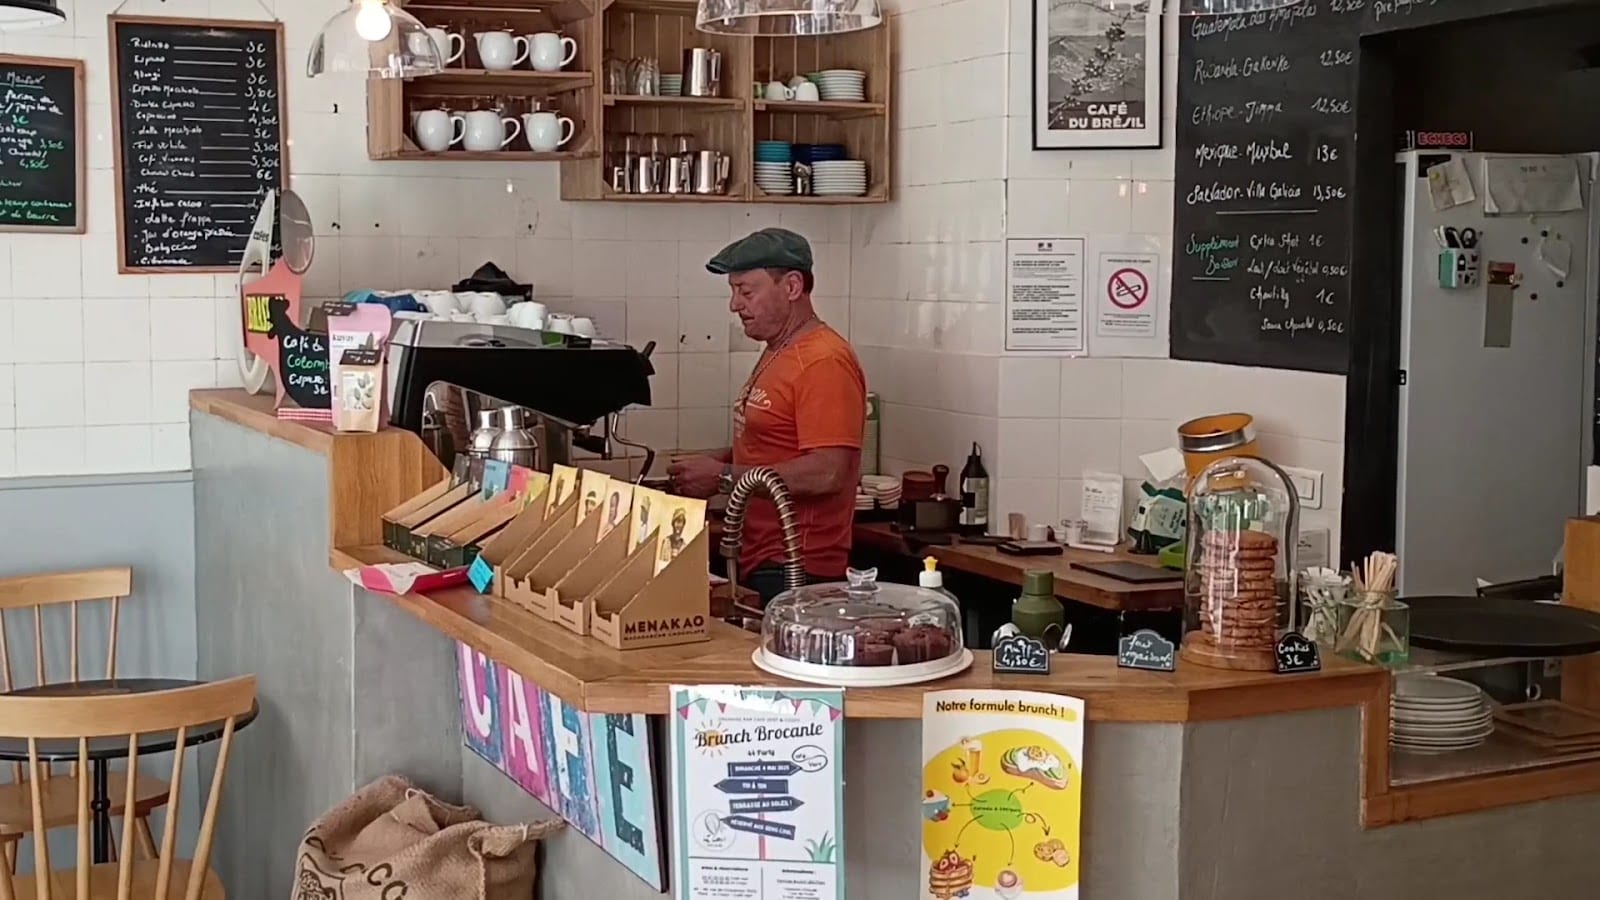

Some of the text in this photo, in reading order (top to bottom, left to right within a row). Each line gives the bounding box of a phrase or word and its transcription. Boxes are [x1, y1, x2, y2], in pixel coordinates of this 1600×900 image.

[1087, 101, 1128, 116] CAFÉ
[1069, 115, 1144, 128] DU BRÉSIL
[1316, 144, 1339, 162] 13€
[283, 335, 309, 353] Café
[625, 615, 704, 634] MENAKAO
[1002, 653, 1041, 667] 4,50€
[936, 700, 966, 713] Notre
[969, 698, 1015, 713] formule
[1018, 700, 1058, 717] brunch
[694, 722, 823, 747] Brunch Brocante
